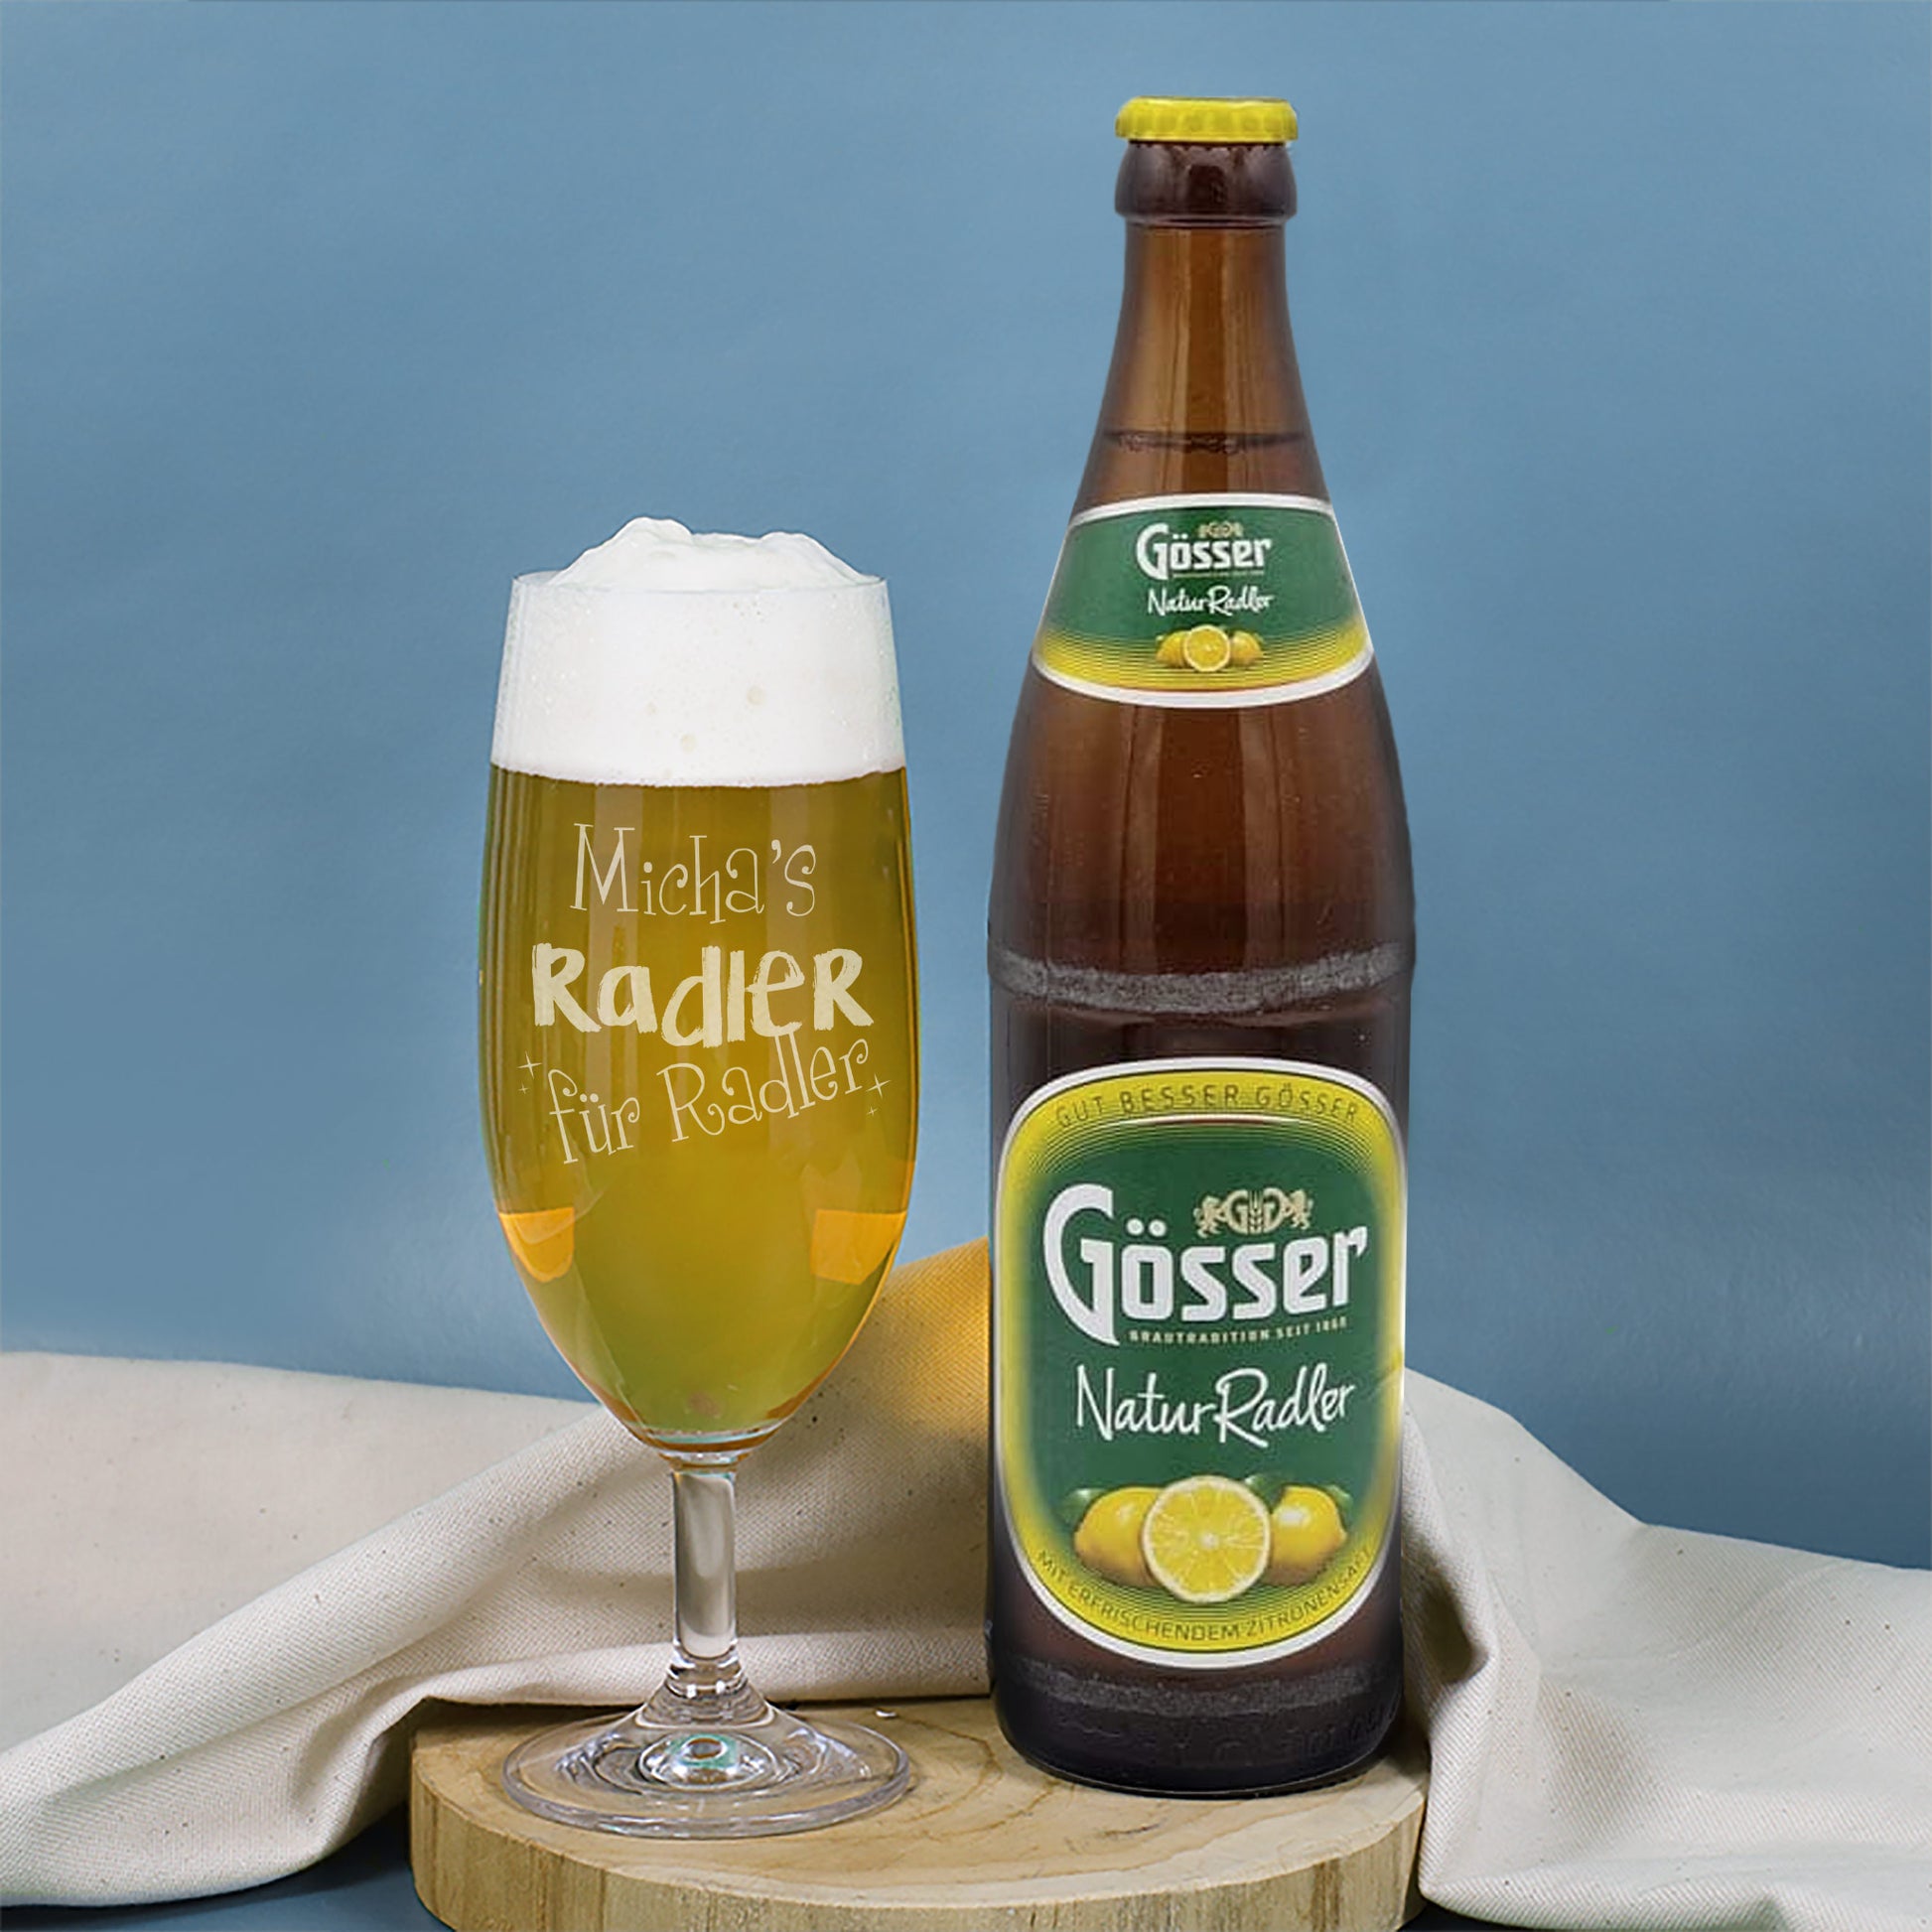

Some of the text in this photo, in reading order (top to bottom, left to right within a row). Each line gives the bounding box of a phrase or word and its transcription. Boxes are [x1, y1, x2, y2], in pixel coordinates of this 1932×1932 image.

[1136, 522, 1272, 580] Gösser
[570, 823, 817, 924] Micha's
[547, 1035, 869, 1165] für Radler
[1054, 1083, 1357, 1128] GUT BESSER GÖSSER
[1043, 1182, 1368, 1346] Gösser
[1036, 1549, 1067, 1584] MIT
[1067, 1584, 1240, 1642] ERFRISCHENDEM
